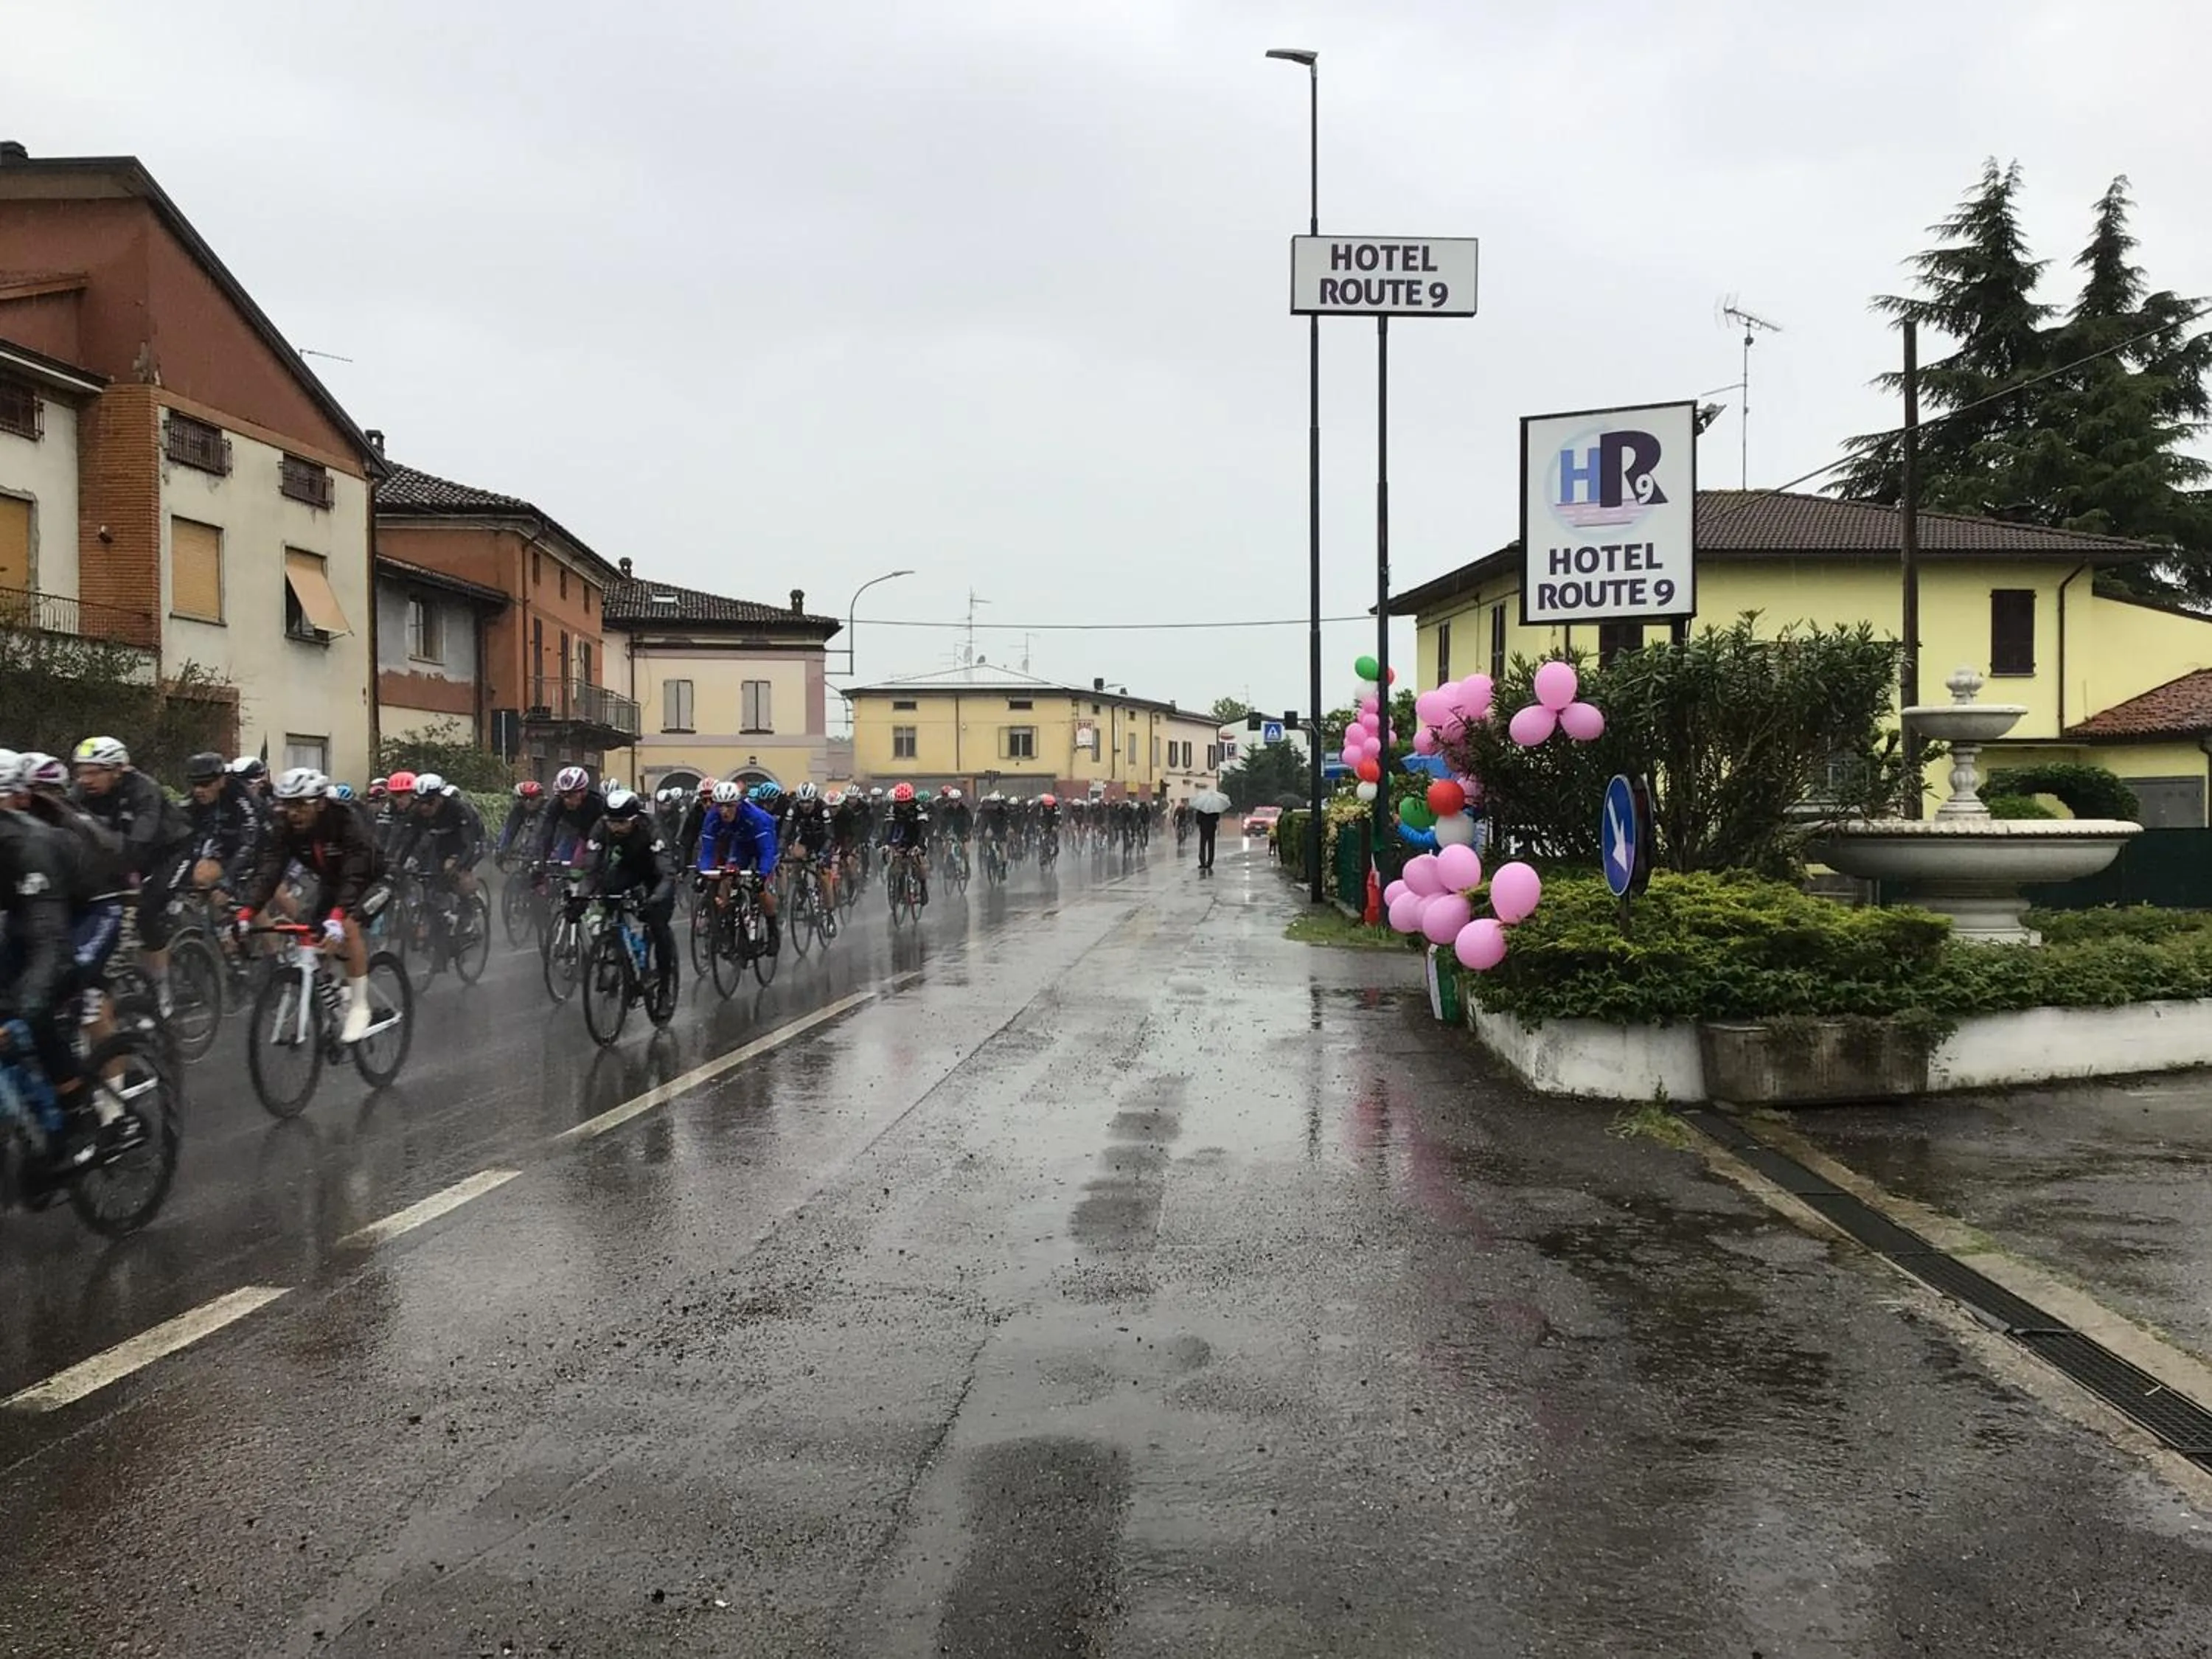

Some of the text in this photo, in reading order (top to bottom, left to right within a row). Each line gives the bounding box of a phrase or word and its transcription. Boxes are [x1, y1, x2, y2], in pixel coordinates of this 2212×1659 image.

[1331, 243, 1439, 272] HOTEL
[1319, 277, 1449, 308] ROUTE 9
[1549, 542, 1663, 576] HOTEL
[1537, 577, 1675, 611] ROUTE 9
